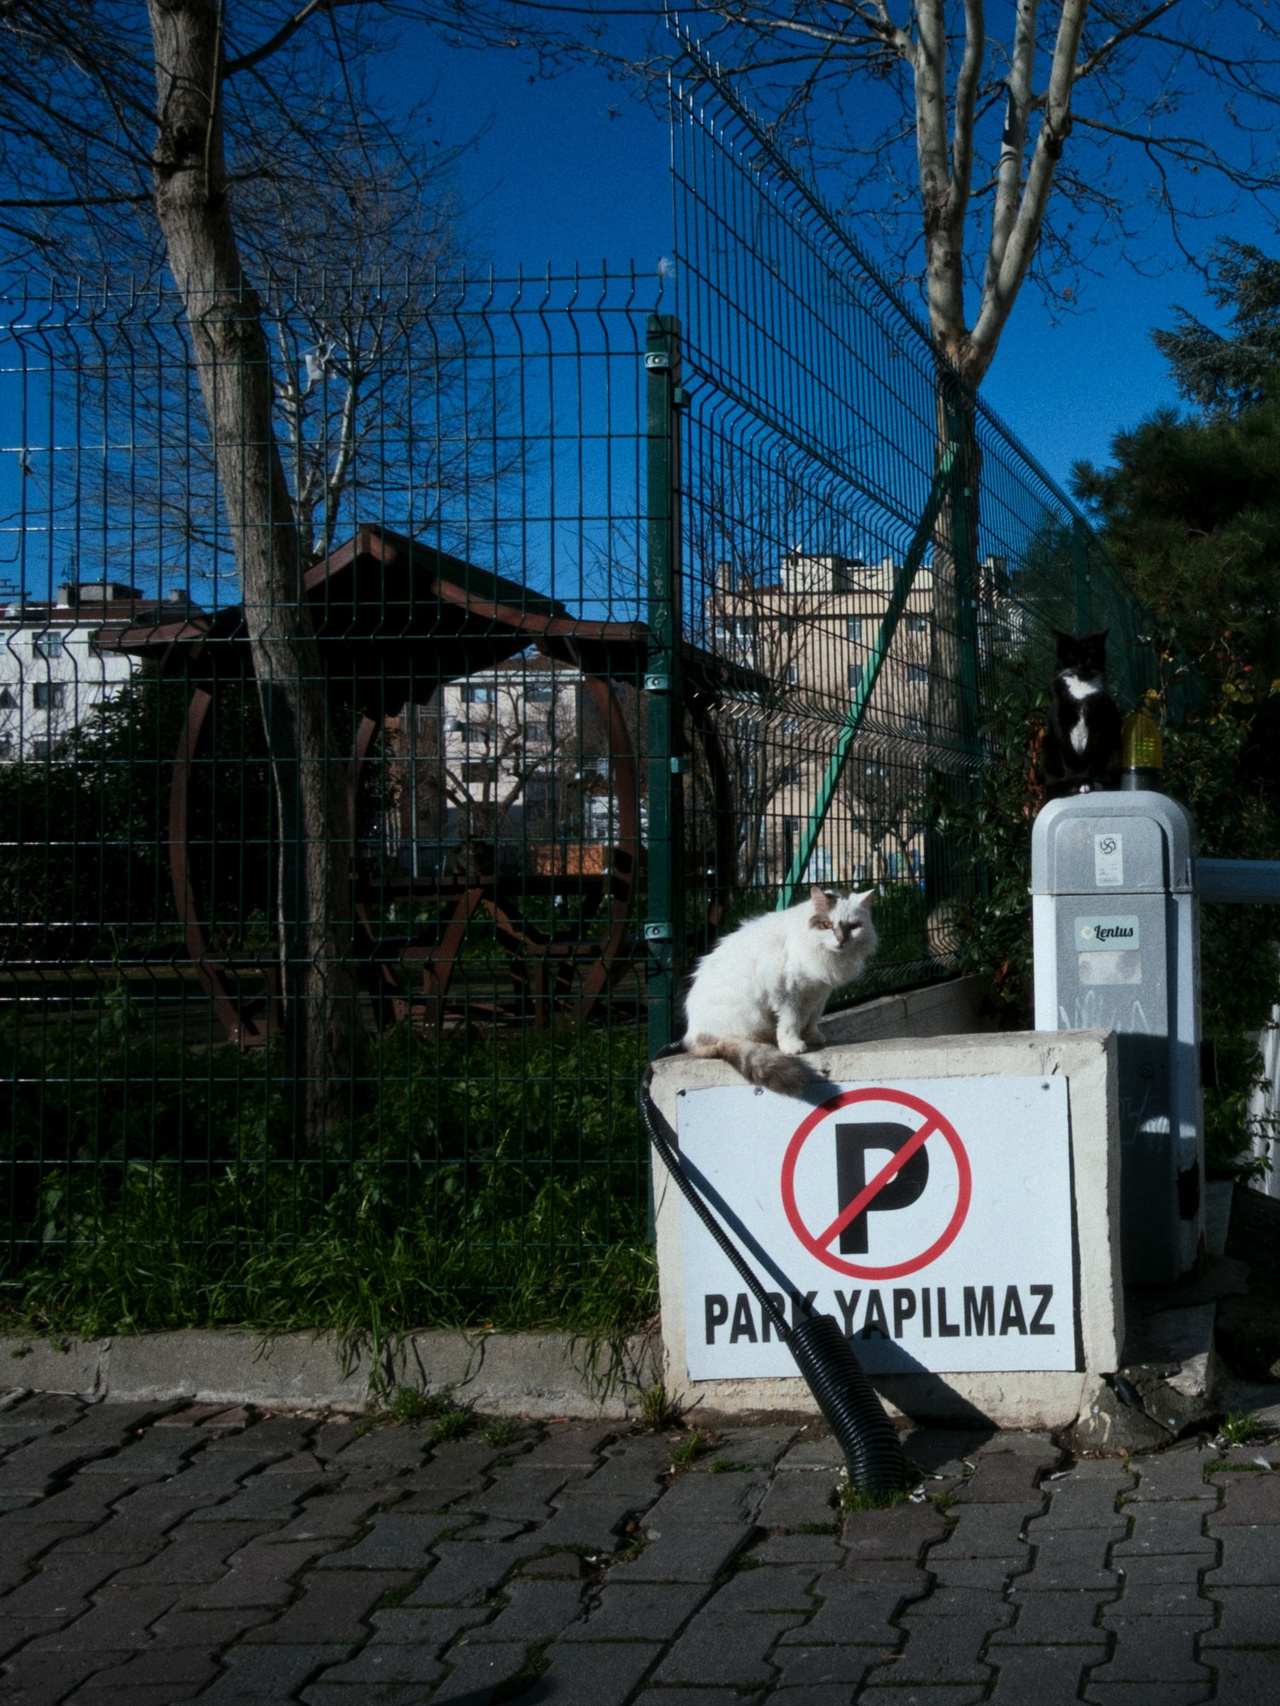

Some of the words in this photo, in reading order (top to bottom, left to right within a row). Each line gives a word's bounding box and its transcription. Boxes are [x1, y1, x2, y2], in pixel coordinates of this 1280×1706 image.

[1094, 924, 1135, 942] Lentus
[835, 1121, 930, 1255] P
[833, 1284, 1056, 1342] YAPILMAZ
